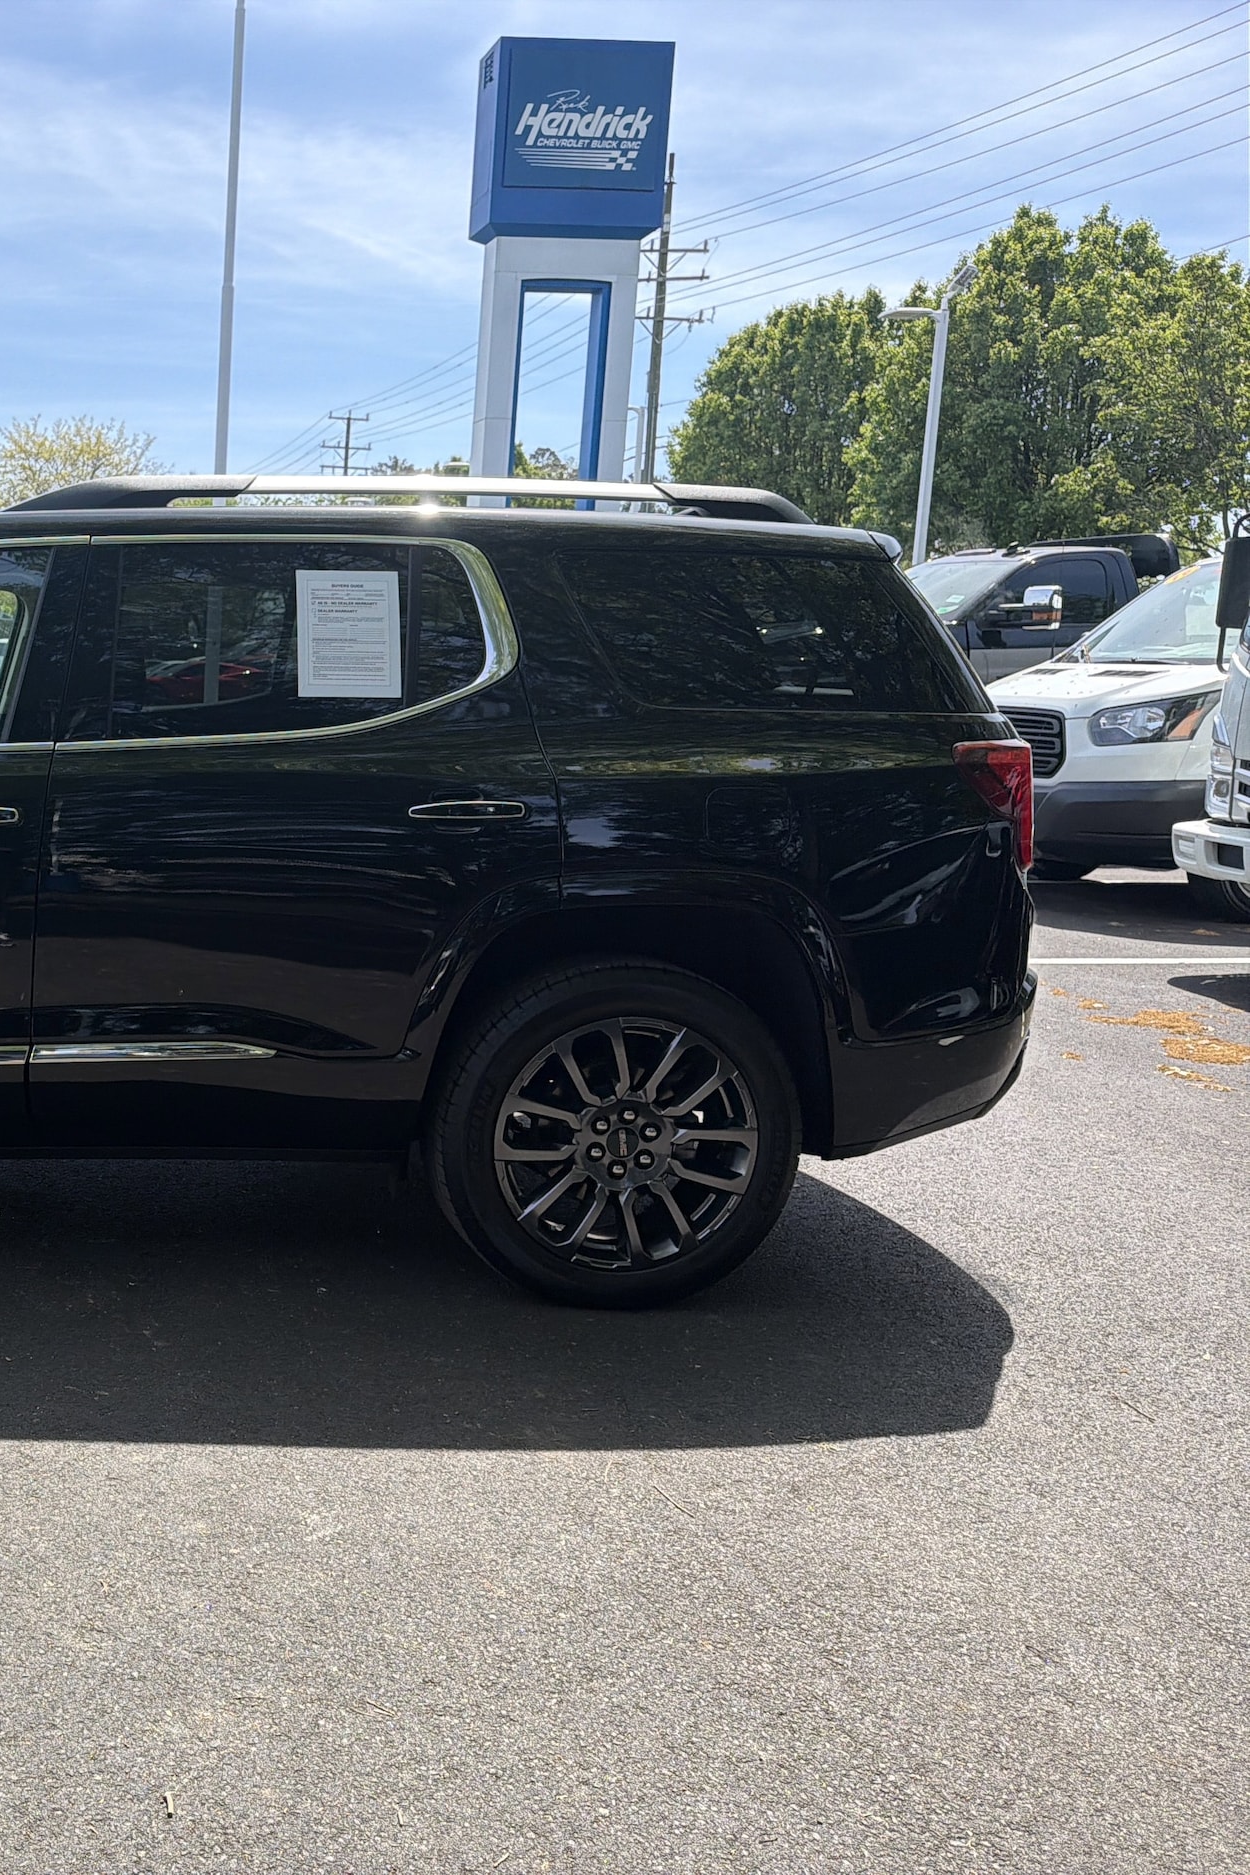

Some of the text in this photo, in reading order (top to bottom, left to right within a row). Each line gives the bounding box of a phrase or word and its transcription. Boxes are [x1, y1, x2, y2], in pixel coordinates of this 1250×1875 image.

[515, 103, 653, 146] Hendrick
[537, 138, 642, 150] CHEVROLET BUICK GMC
